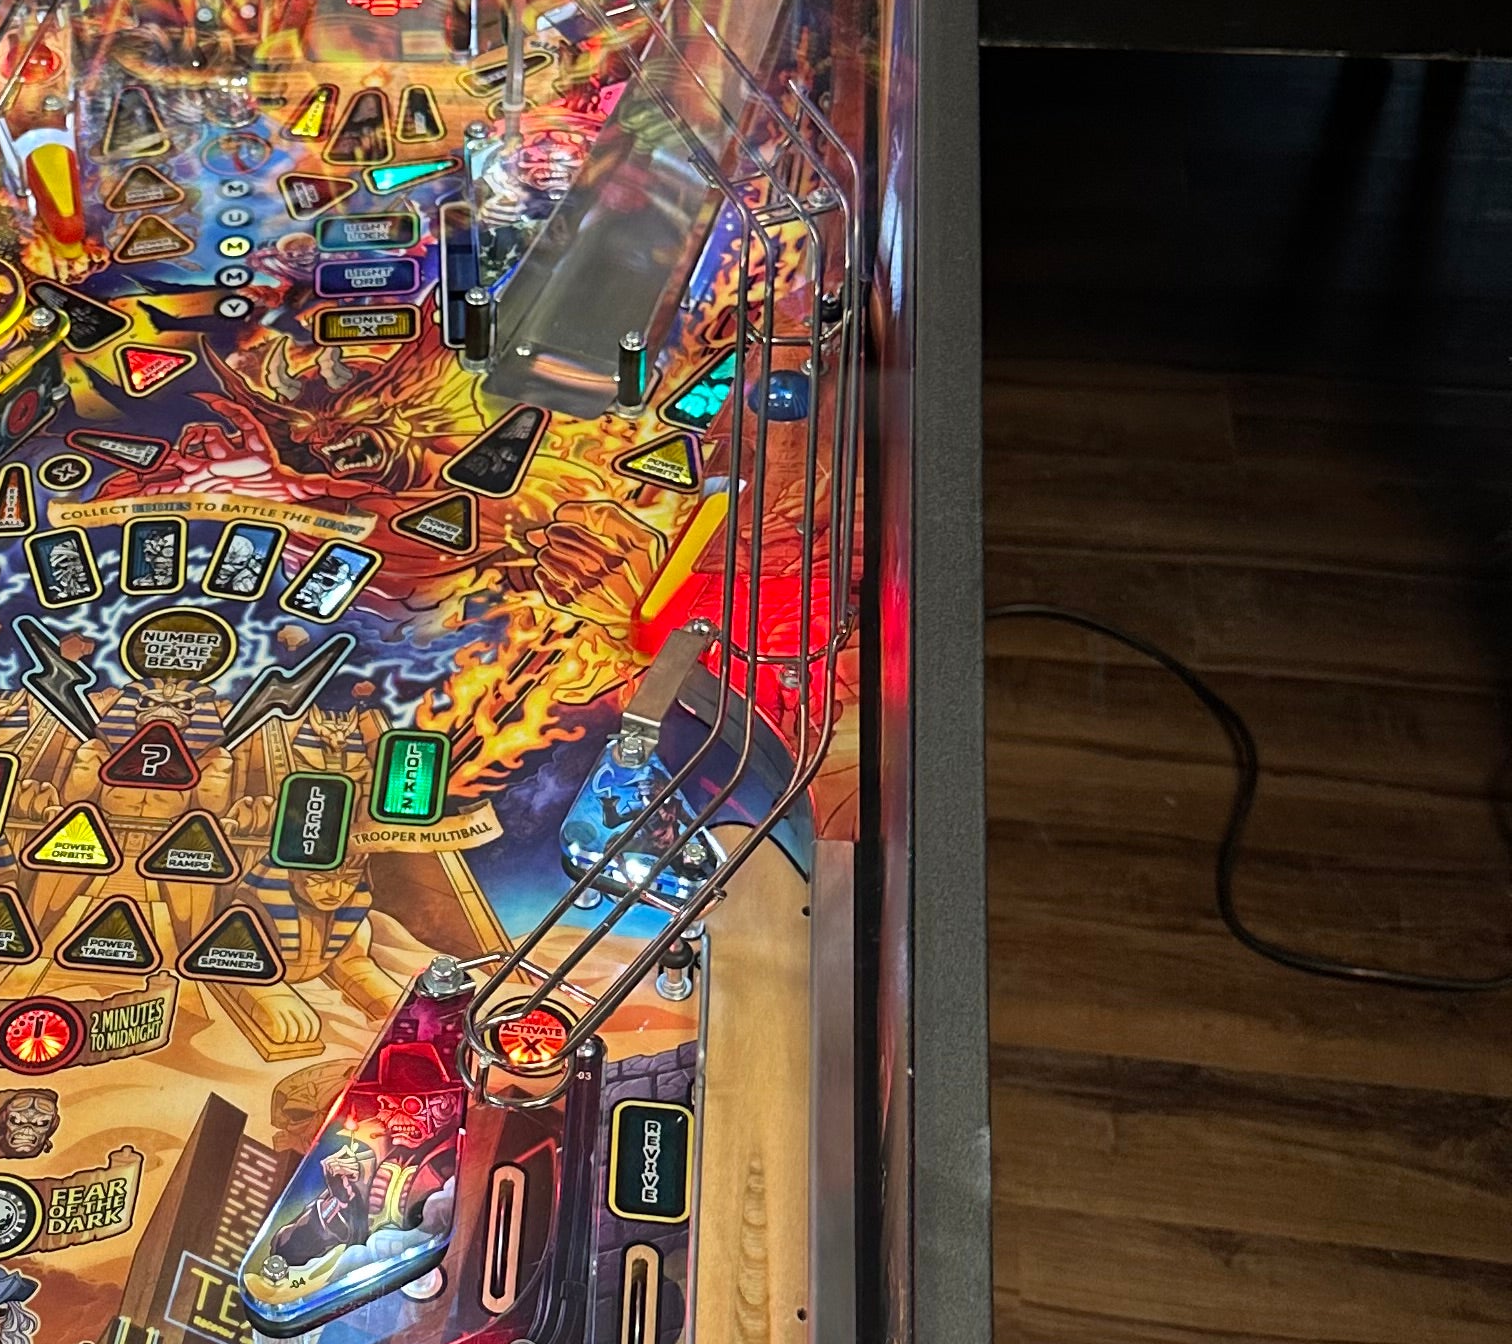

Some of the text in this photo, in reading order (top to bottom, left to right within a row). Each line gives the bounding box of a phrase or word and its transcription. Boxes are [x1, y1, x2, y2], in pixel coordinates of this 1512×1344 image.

[341, 313, 396, 326] BONUS
[61, 501, 366, 536] COLLECT TO BATTLE THE BEAST
[141, 630, 221, 647] NUMBER
[146, 643, 212, 658] OF THE
[145, 656, 208, 671] BEAST
[402, 742, 423, 794] LOCK
[301, 785, 325, 855] LOCK 1
[352, 821, 493, 846] TROOPER MULTIBALL
[51, 849, 95, 861] ORBITS
[54, 840, 96, 853] POWER
[169, 849, 212, 862] POWER
[168, 858, 211, 871] RAMPS
[89, 937, 133, 950] POWER
[82, 946, 135, 961] TARGETS
[211, 948, 255, 961] POWER
[198, 957, 263, 971] SPINNERS
[90, 996, 165, 1034] 2 MINUTES
[89, 1020, 163, 1051] TO MIDNIGHT
[501, 1021, 563, 1038] ACTIVATE
[521, 1036, 542, 1054] X
[641, 1118, 662, 1205] REVIVE
[49, 1177, 126, 1208] FEAR
[47, 1192, 126, 1220] OF THE
[46, 1211, 124, 1238] DARK
